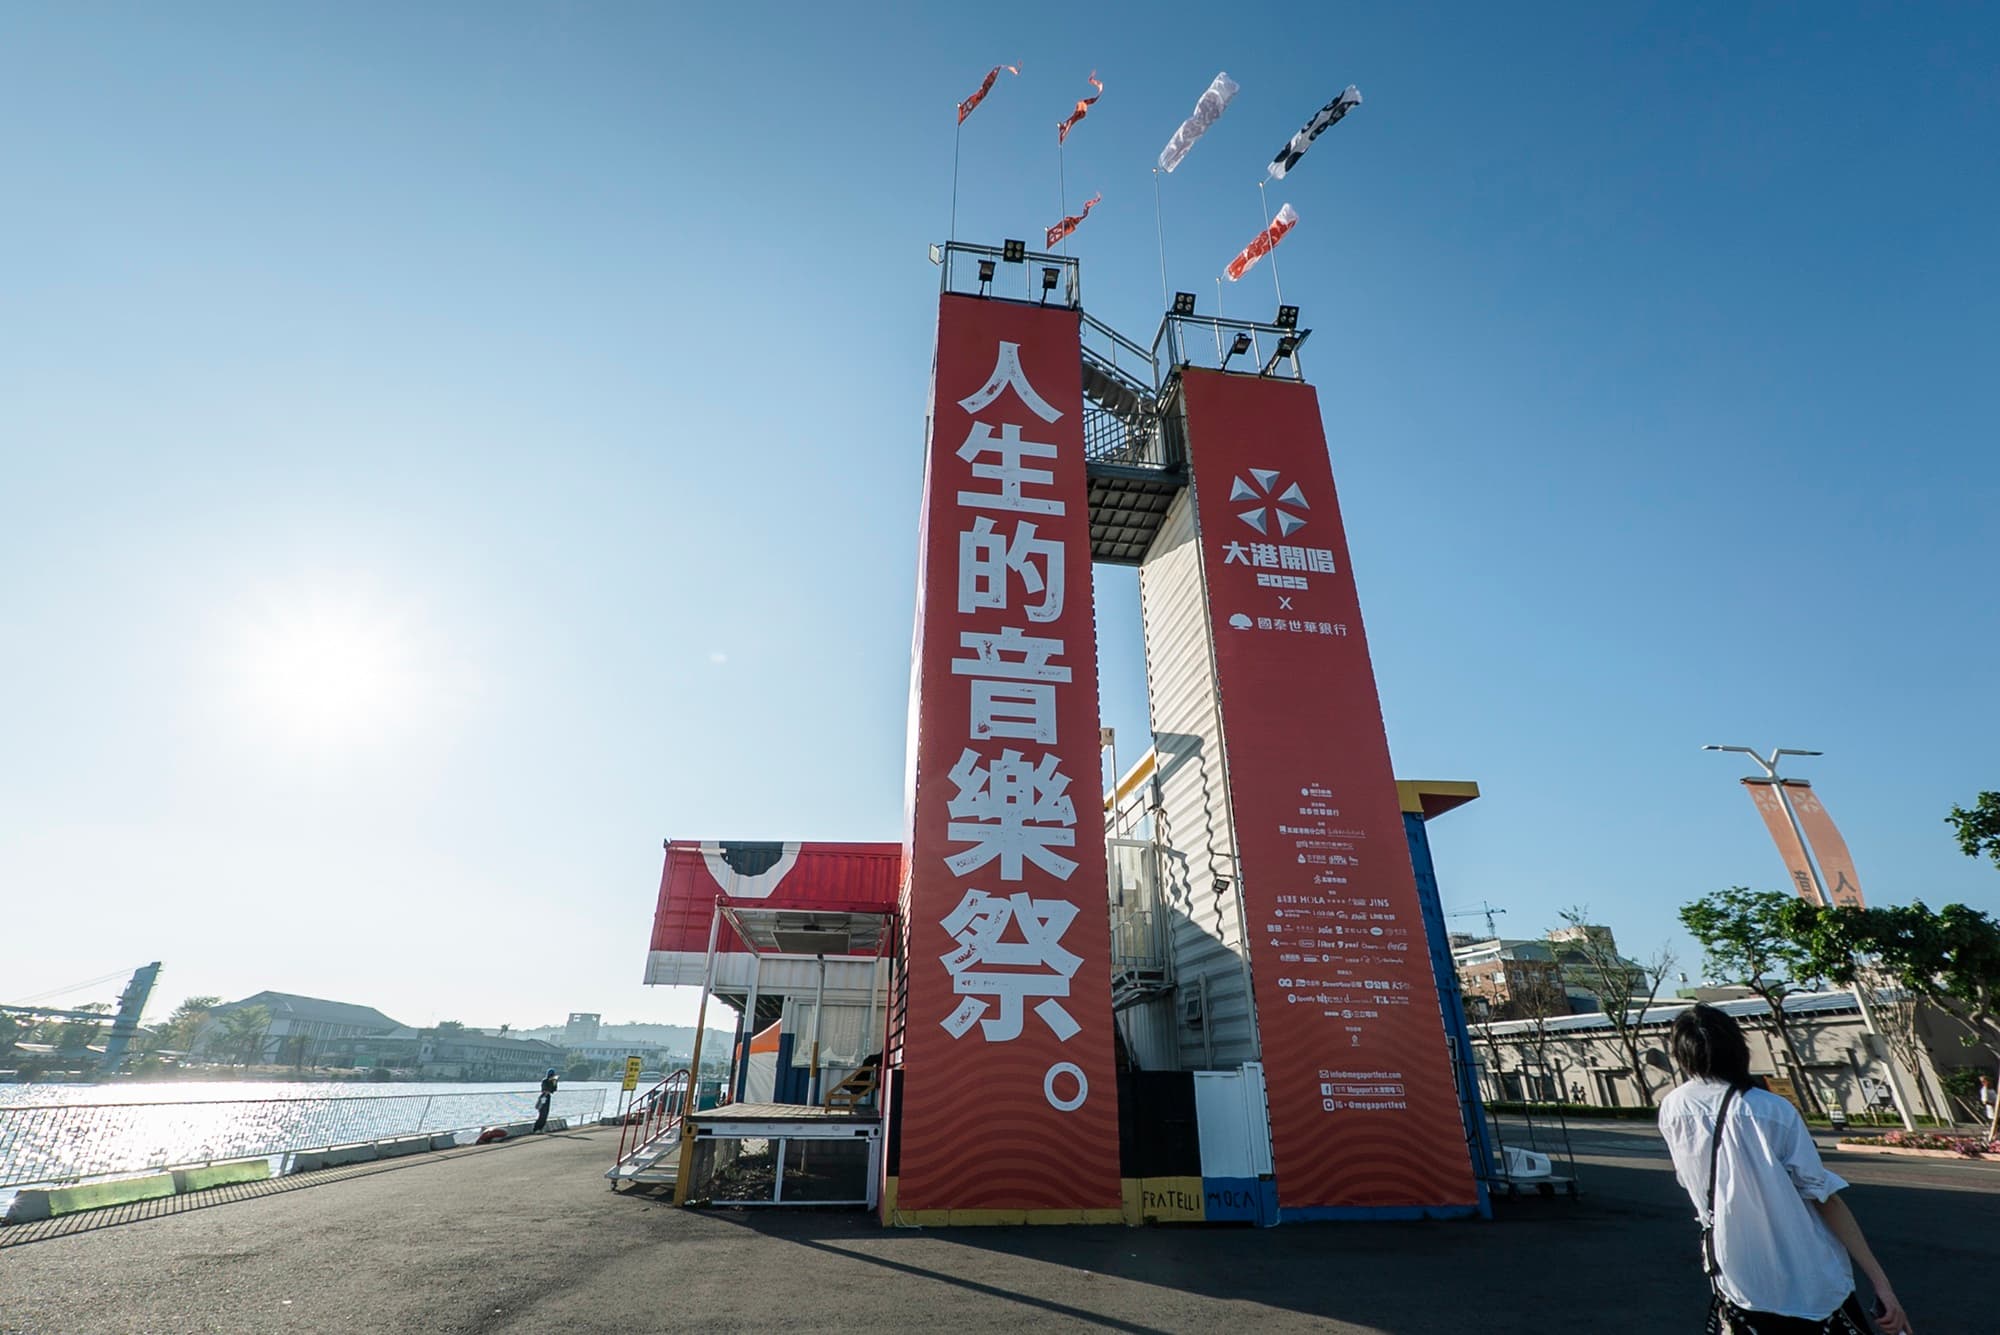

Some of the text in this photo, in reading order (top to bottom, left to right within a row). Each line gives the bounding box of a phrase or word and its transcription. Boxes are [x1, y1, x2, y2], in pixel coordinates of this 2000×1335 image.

[1222, 541, 1336, 574] 大港開唱
[1256, 573, 1309, 590] 2025
[1257, 616, 1347, 637] 國泰世華銀行
[938, 340, 1089, 1112] 人生的音樂祭。
[1300, 895, 1326, 904] HOLA
[1369, 898, 1390, 907] JINS
[1143, 1189, 1256, 1212] FRATELLI MOCA
